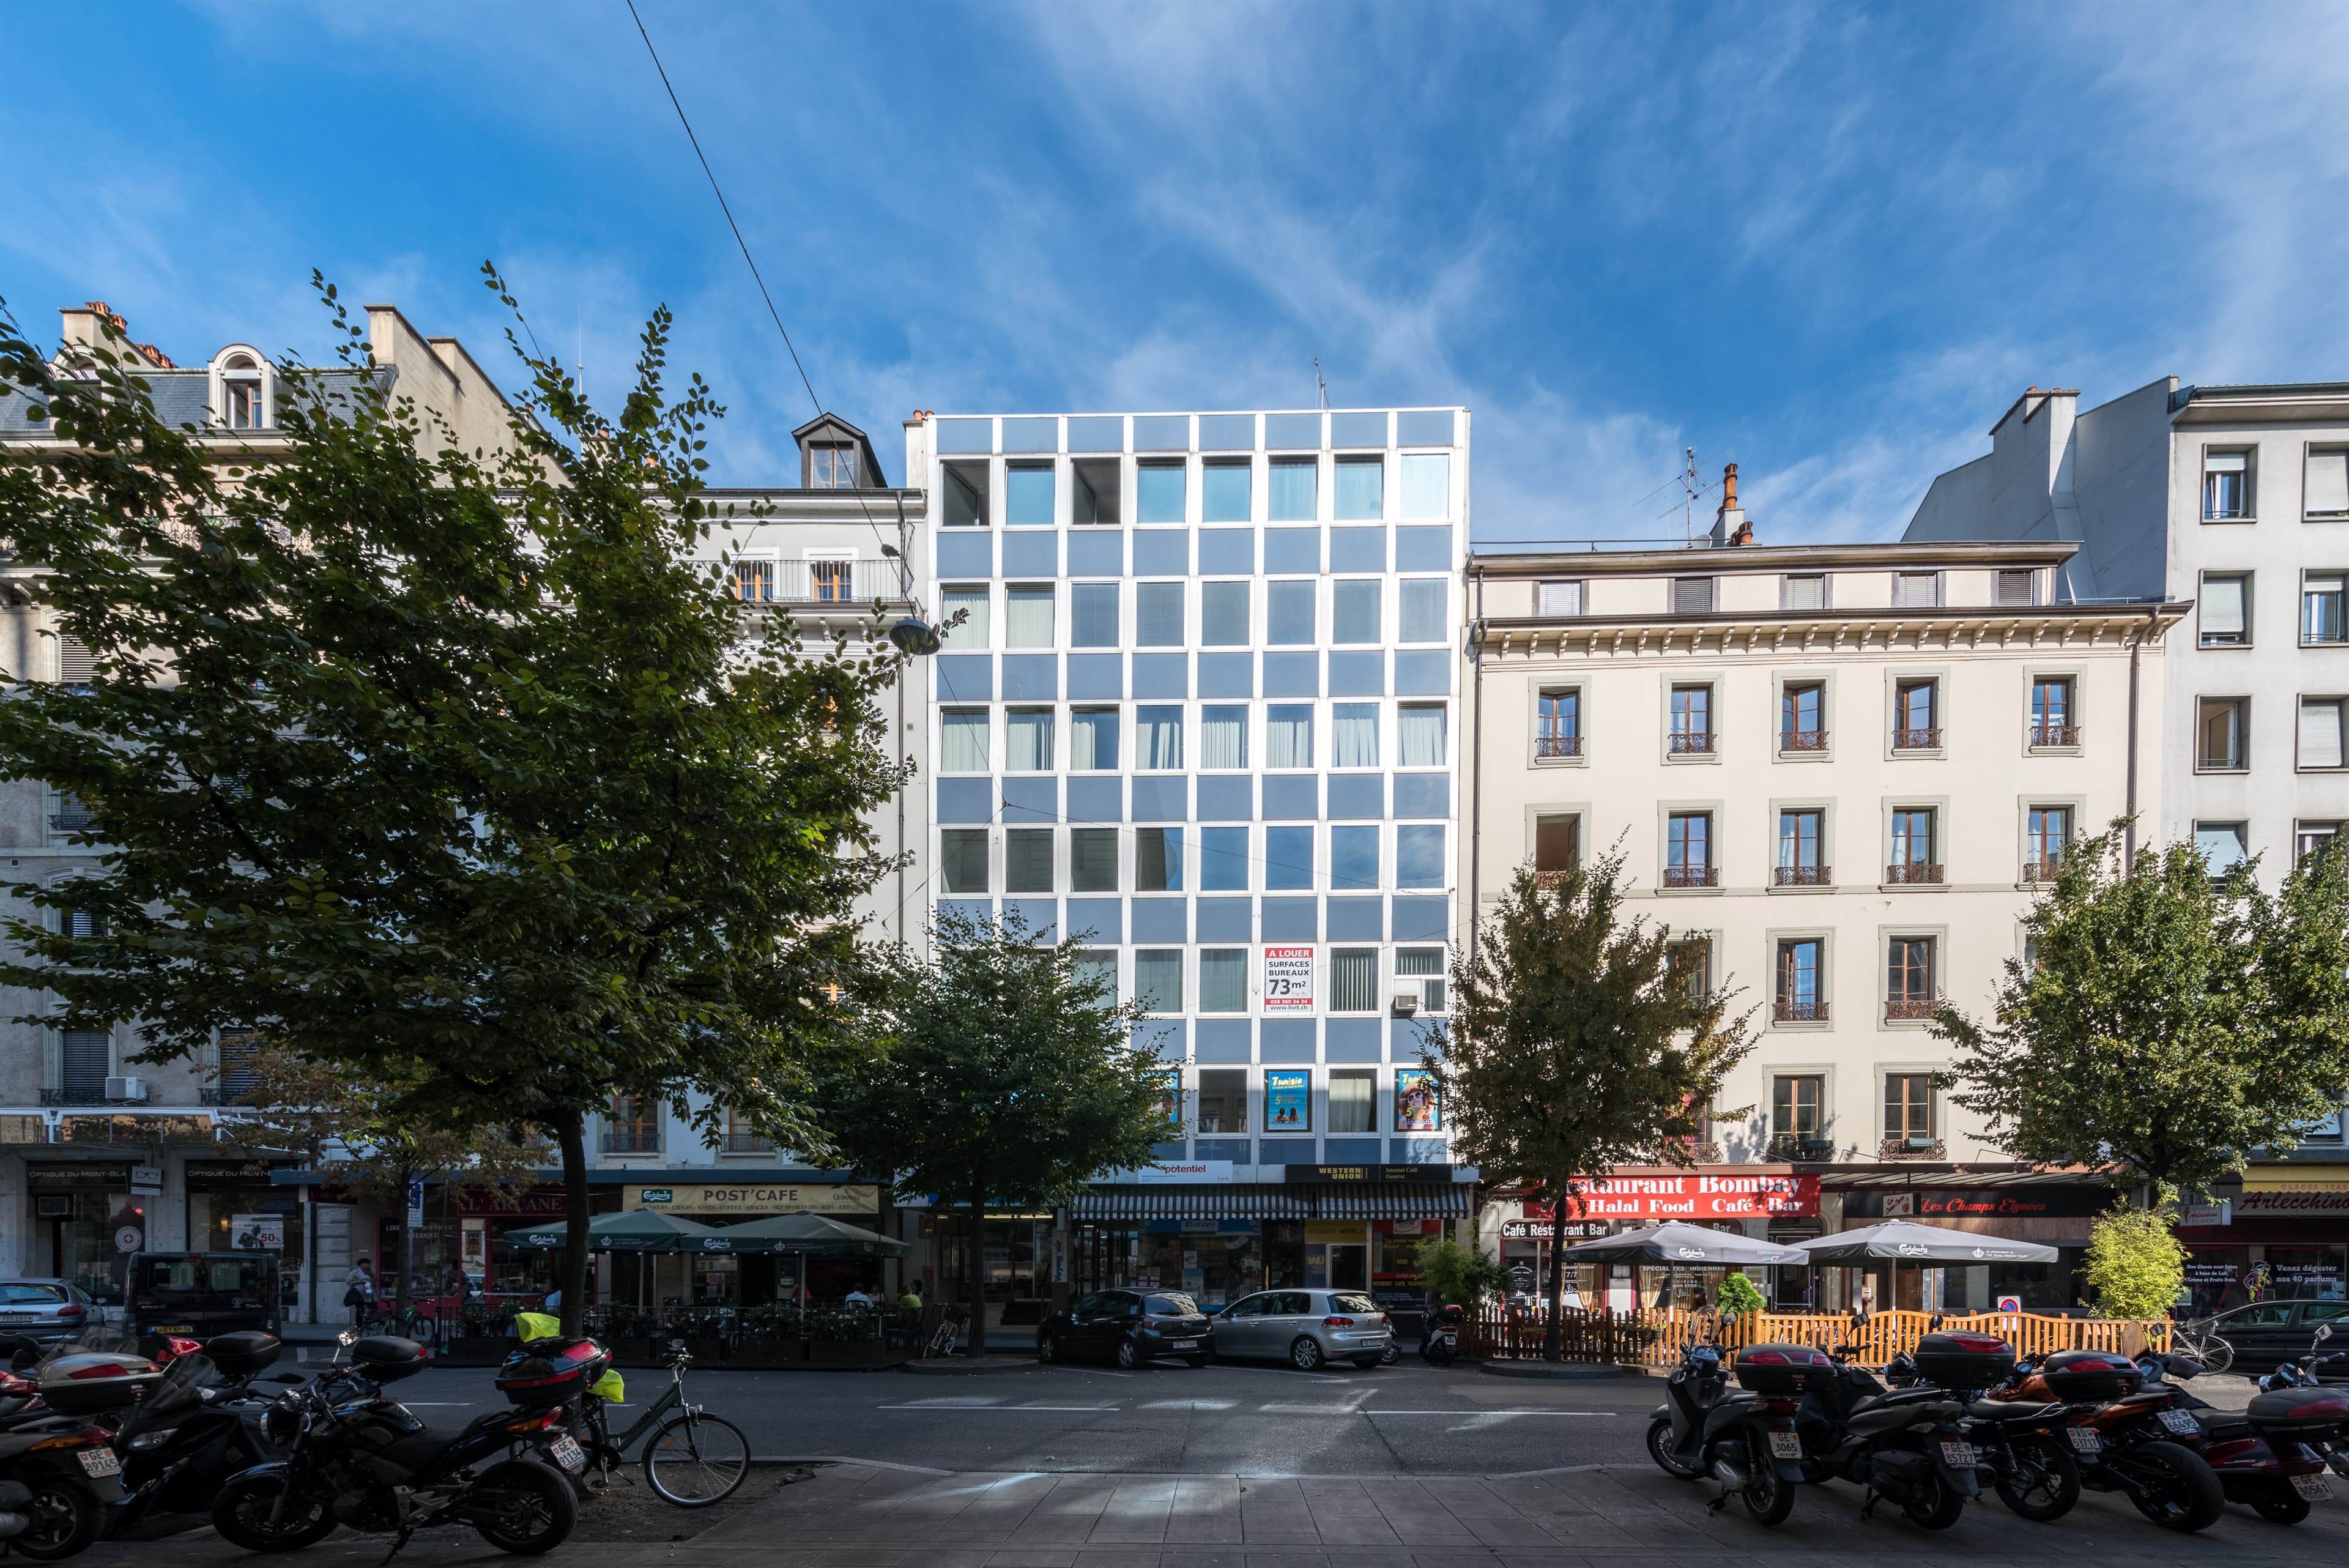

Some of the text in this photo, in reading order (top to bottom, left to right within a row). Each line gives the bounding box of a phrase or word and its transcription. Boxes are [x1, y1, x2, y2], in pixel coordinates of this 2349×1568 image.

[1269, 979, 1291, 995] 73
[1272, 1076, 1302, 1087] Tunisie
[1165, 1164, 1206, 1174] potentiel
[1697, 1174, 1803, 1198] Bombay
[644, 1191, 670, 1202] Carlsberg
[704, 1189, 798, 1202] POST'CAFE
[1588, 1198, 1639, 1213] Halal
[1648, 1198, 1694, 1213] Food
[1711, 1197, 1754, 1213] Café
[1767, 1197, 1803, 1211] Bar
[1920, 1198, 1943, 1213] Les
[1946, 1197, 1996, 1214] Champs
[1502, 1223, 1608, 1237] Café Restarant Bar
[529, 1234, 557, 1245] Carlsberg
[703, 1238, 732, 1249] Carlsberg
[1679, 1247, 1705, 1258] Carlsberg
[1899, 1243, 1928, 1255] Carlsberg
[2304, 1264, 2337, 1273] déguster
[2167, 1411, 2182, 1420] GE
[2168, 1418, 2197, 1430] 66495
[1778, 1433, 1791, 1441] GE
[2075, 1429, 2087, 1438] VD
[558, 1441, 571, 1453] GE
[1775, 1443, 1797, 1452] 3065
[1950, 1443, 1964, 1452] GE
[2073, 1438, 2097, 1447] 53717
[89, 1450, 105, 1460] GE
[559, 1447, 582, 1465] 91134
[1946, 1454, 1973, 1462] 85727
[2300, 1474, 2315, 1485] GE
[2298, 1484, 2330, 1496] 30561
